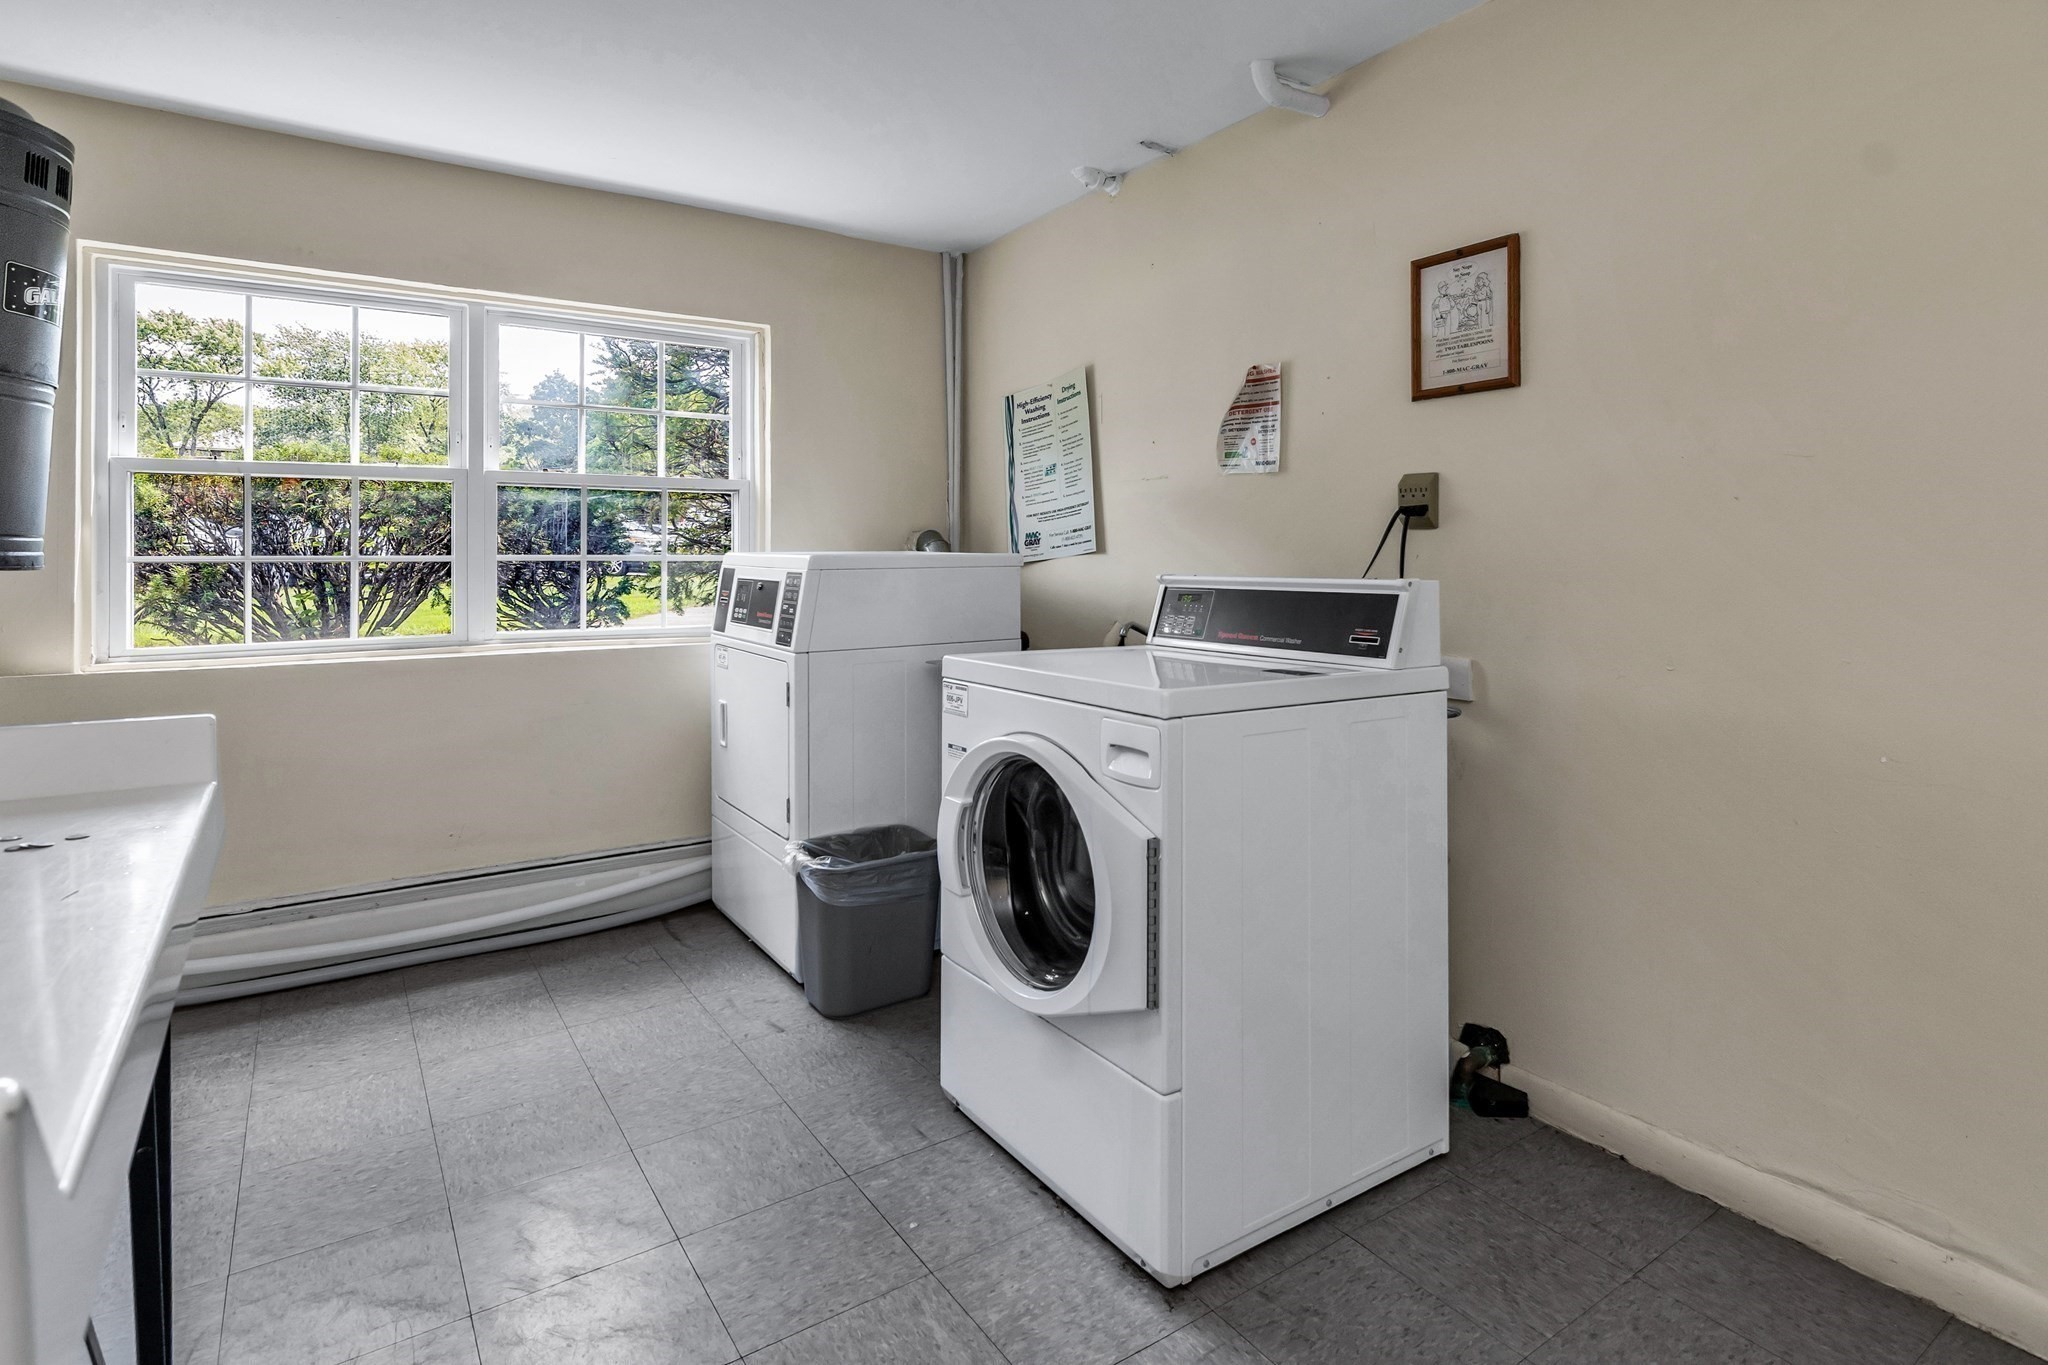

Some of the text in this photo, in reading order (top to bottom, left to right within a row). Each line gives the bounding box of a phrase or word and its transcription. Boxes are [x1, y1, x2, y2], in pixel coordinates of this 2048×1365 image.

[1457, 338, 1494, 349] TABLESPOONS
[1442, 362, 1488, 375] 1-800-MAC-GRAY
[1062, 383, 1076, 393] Drying
[1016, 394, 1052, 409] High-Efficiency
[1056, 390, 1081, 404] Instructions
[1024, 404, 1046, 414] Washing
[1228, 408, 1262, 416] DETERGENT
[1021, 412, 1050, 424] Instructions
[1024, 538, 1041, 546] GRAY
